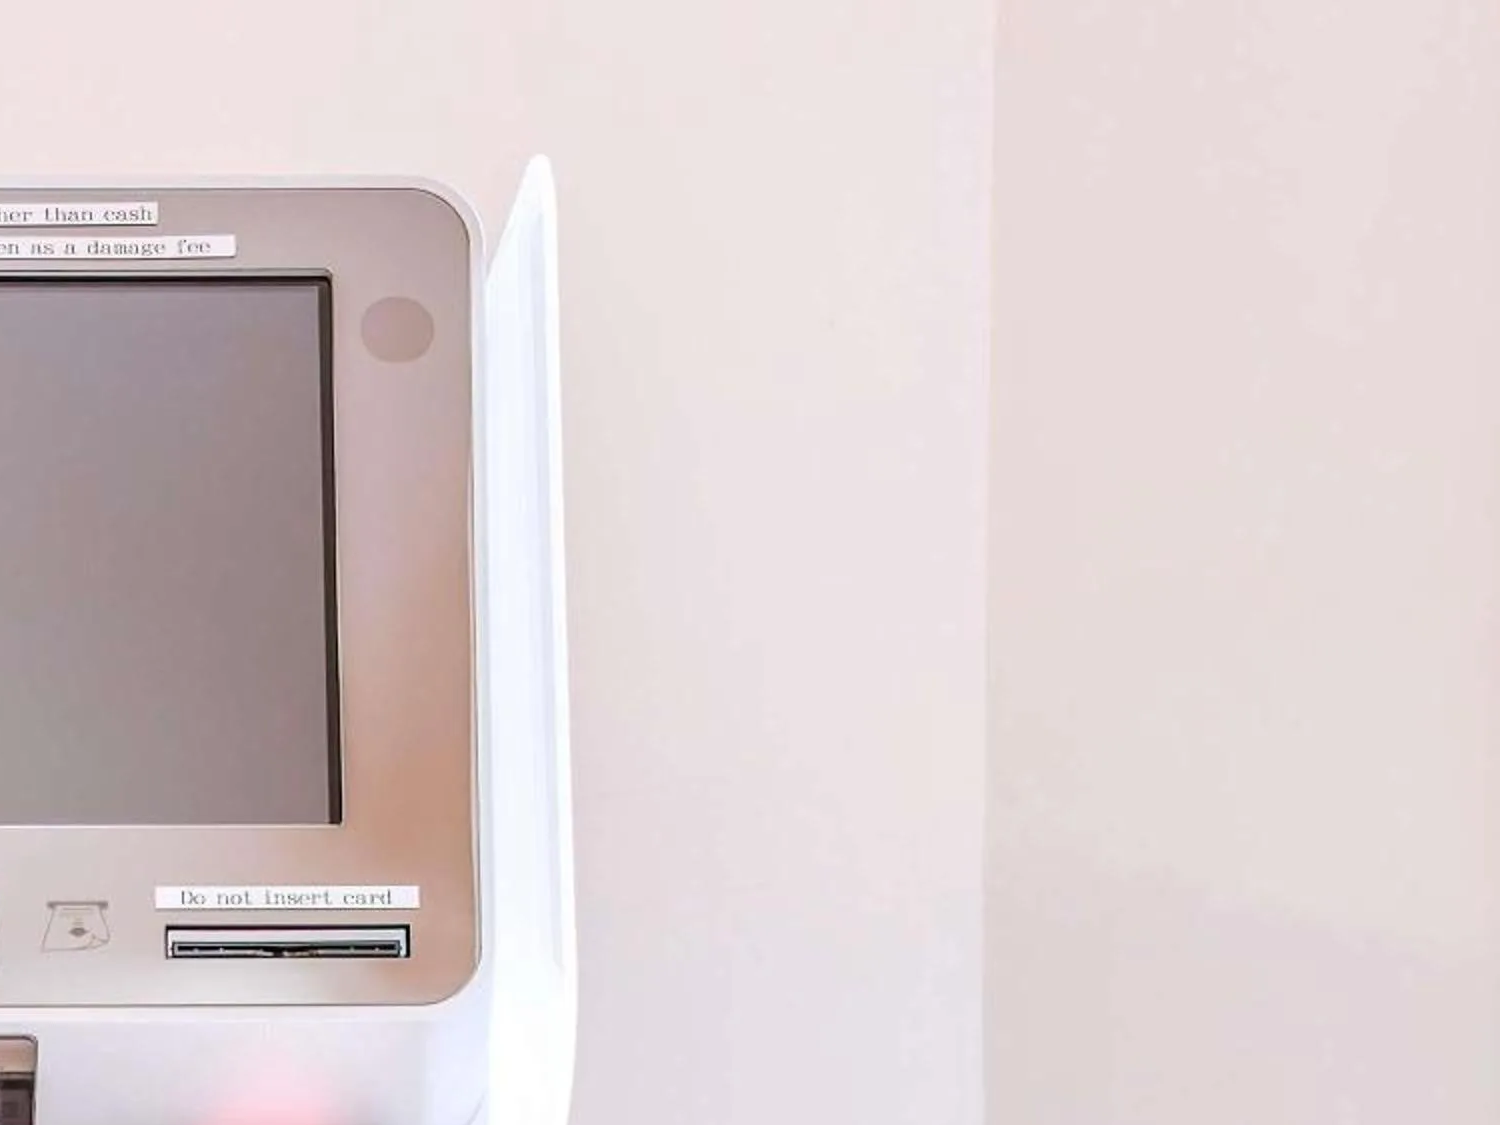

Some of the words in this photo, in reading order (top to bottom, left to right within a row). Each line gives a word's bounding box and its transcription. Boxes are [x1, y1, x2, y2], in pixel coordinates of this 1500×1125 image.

[44, 207, 94, 222] than
[103, 205, 153, 221] cash
[31, 241, 56, 256] as
[64, 242, 77, 256] a
[86, 239, 167, 257] damage
[177, 238, 212, 255] fee
[180, 890, 206, 905] Do
[216, 890, 252, 905] not
[265, 889, 332, 905] insert
[343, 889, 392, 905] card
